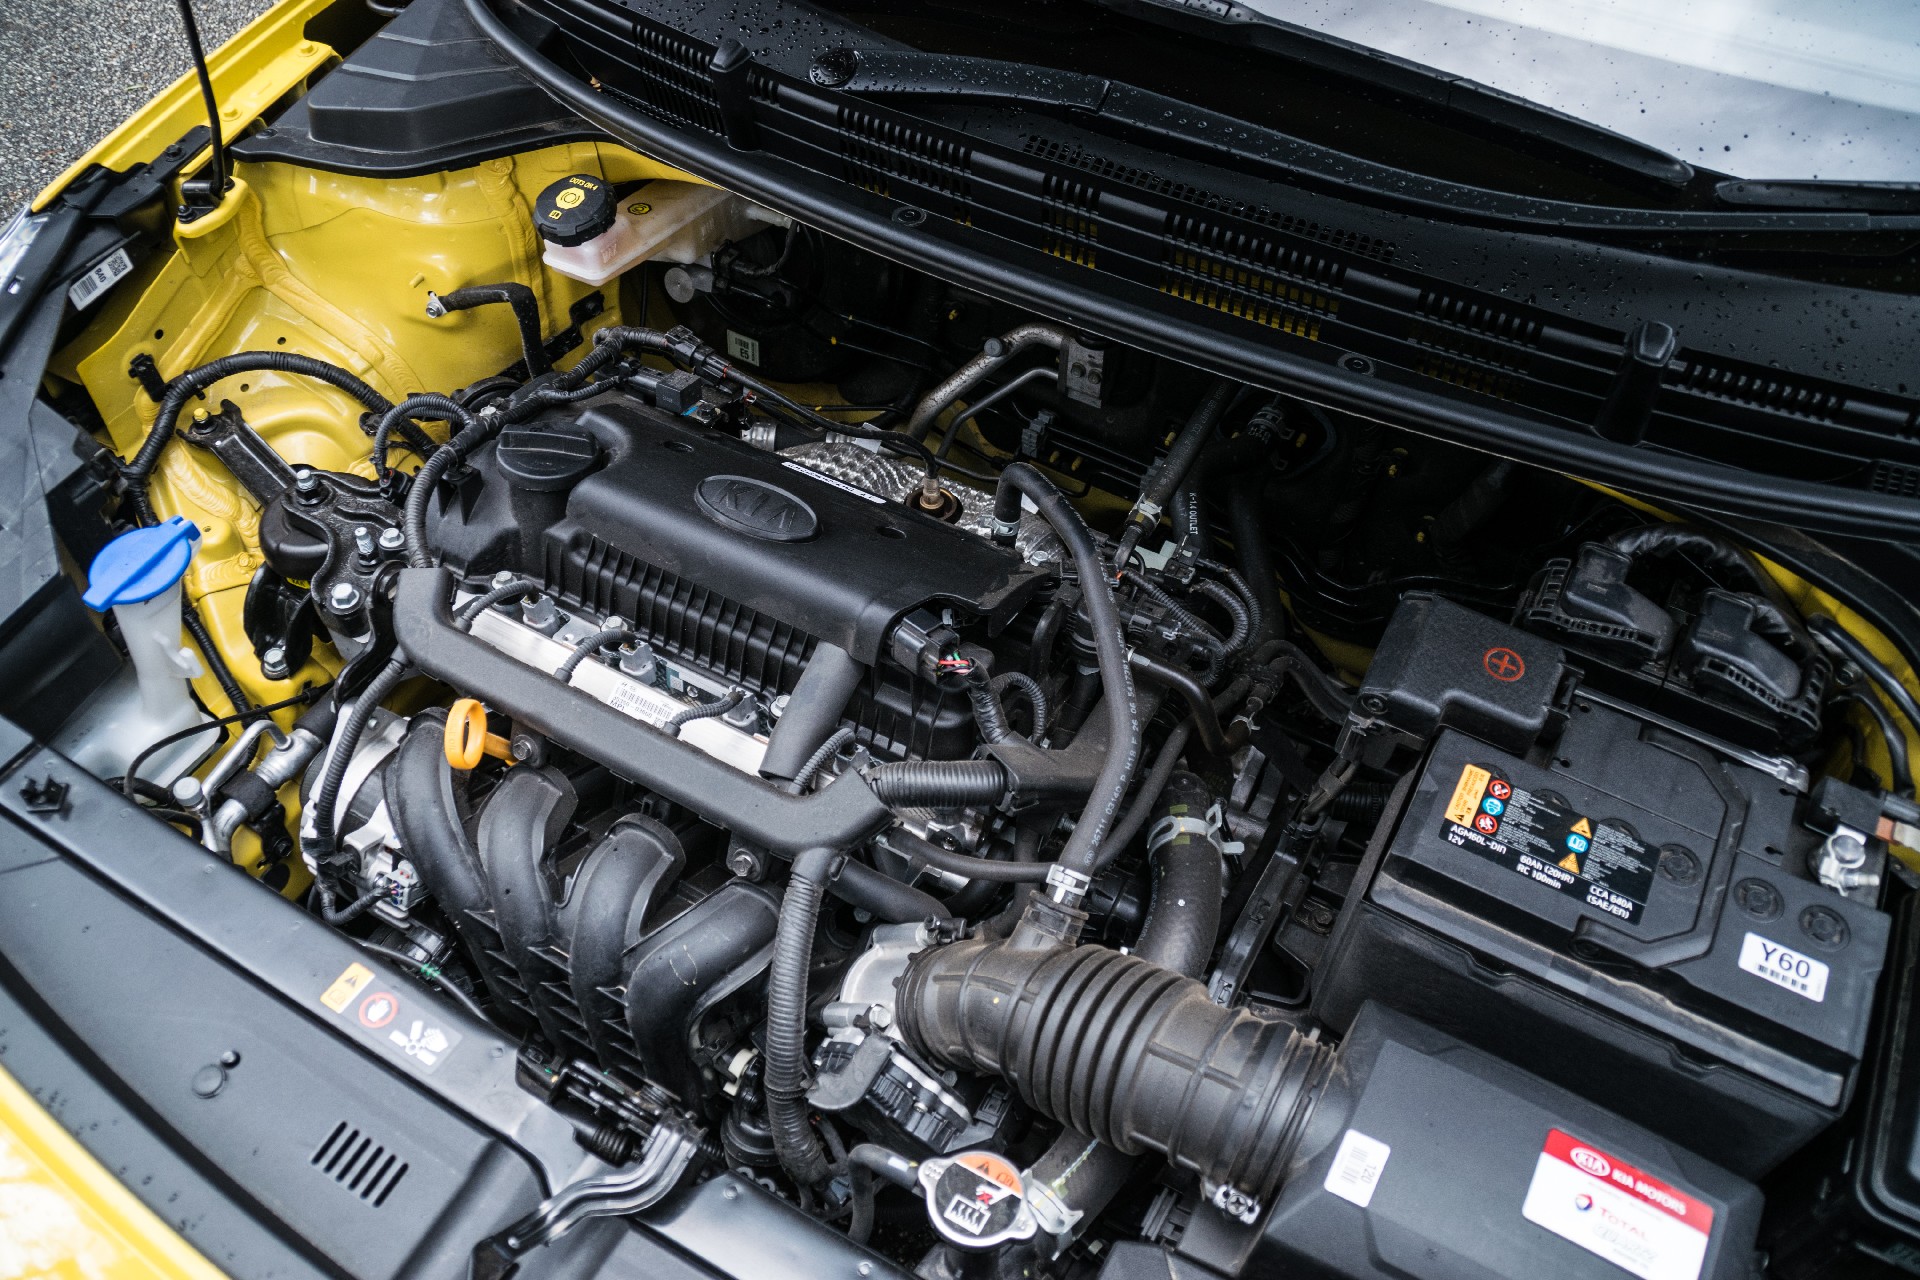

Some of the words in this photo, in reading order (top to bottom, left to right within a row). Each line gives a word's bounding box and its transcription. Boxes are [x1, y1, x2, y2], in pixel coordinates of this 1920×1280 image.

[706, 479, 800, 534] KIA
[1189, 510, 1199, 535] OUTLET
[1448, 833, 1465, 846] 12V
[1516, 862, 1531, 875] RC
[1531, 869, 1562, 889] 100min
[1519, 854, 1543, 871] 60Ah
[1544, 865, 1575, 884] (20HR)
[1589, 884, 1609, 900] CCA
[1761, 942, 1811, 978] Y60
[1360, 1164, 1377, 1184] 120
[1573, 1149, 1608, 1175] KIA
[1611, 1168, 1635, 1189] KIA
[1634, 1180, 1687, 1216] MOTORS
[1600, 1206, 1649, 1241] TOTAL
